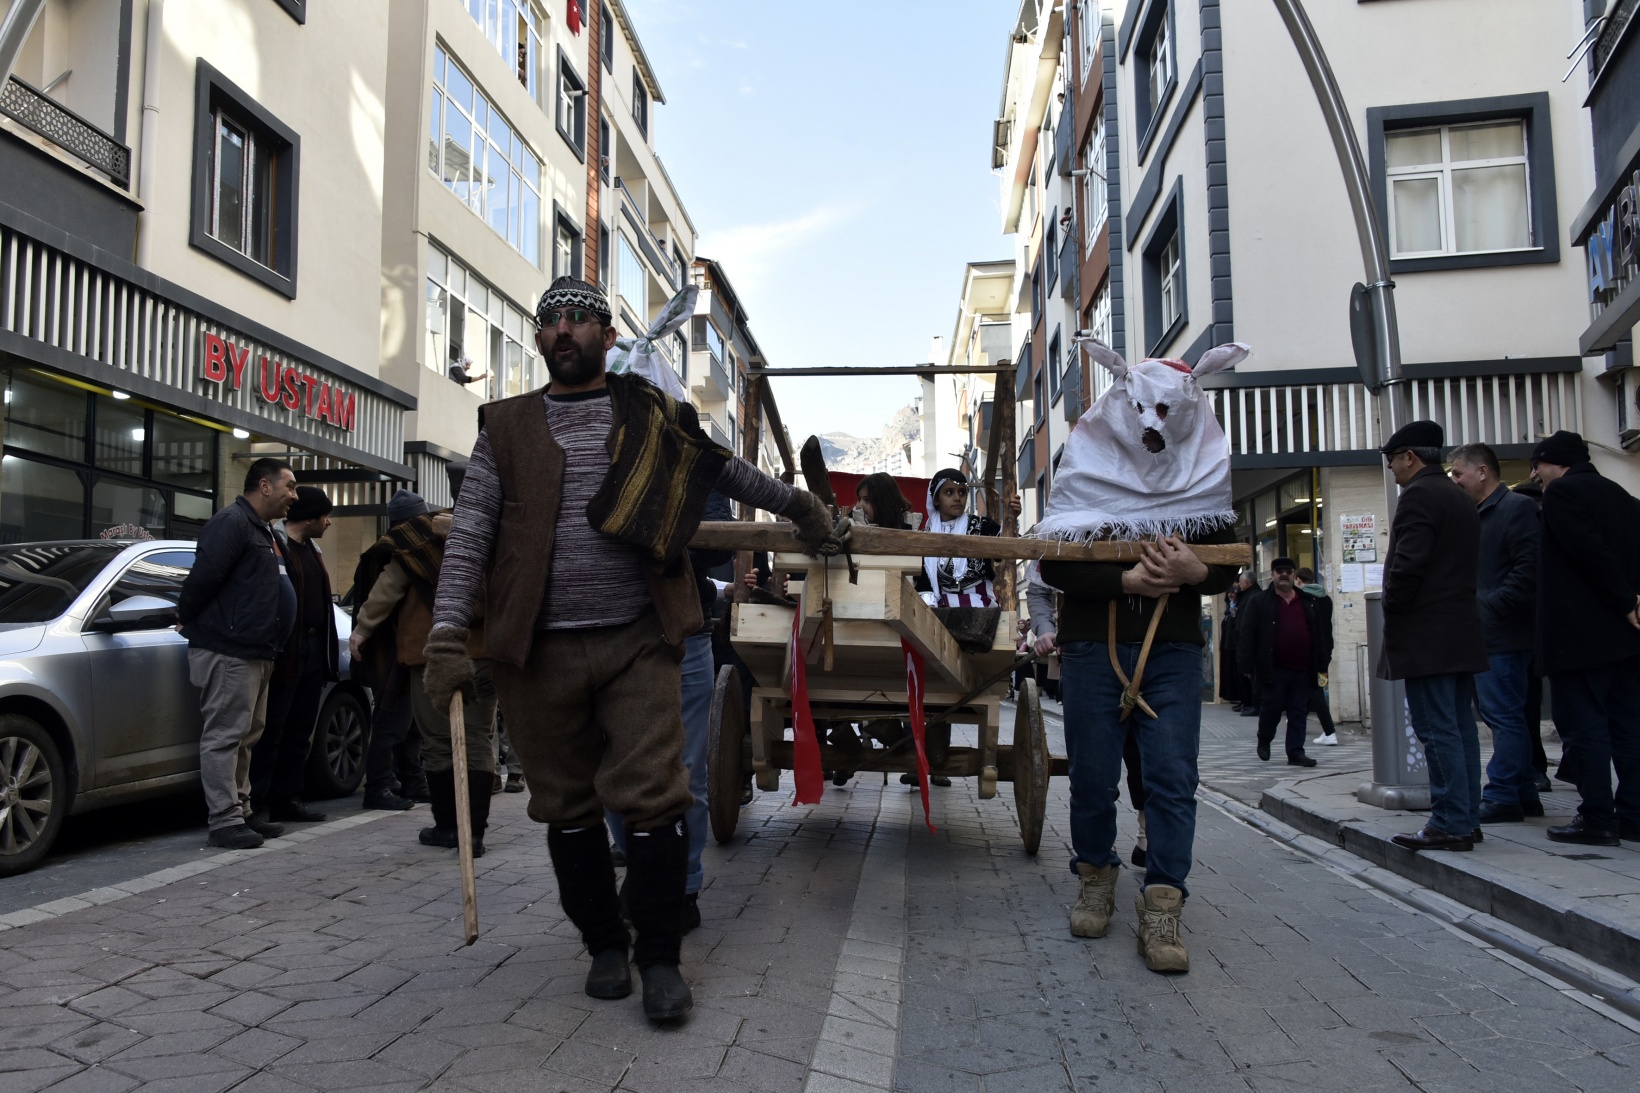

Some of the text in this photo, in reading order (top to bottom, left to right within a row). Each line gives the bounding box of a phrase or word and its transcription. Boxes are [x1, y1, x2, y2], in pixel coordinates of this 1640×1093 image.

[204, 331, 356, 432] BY USTAM
[128, 523, 138, 538] By
